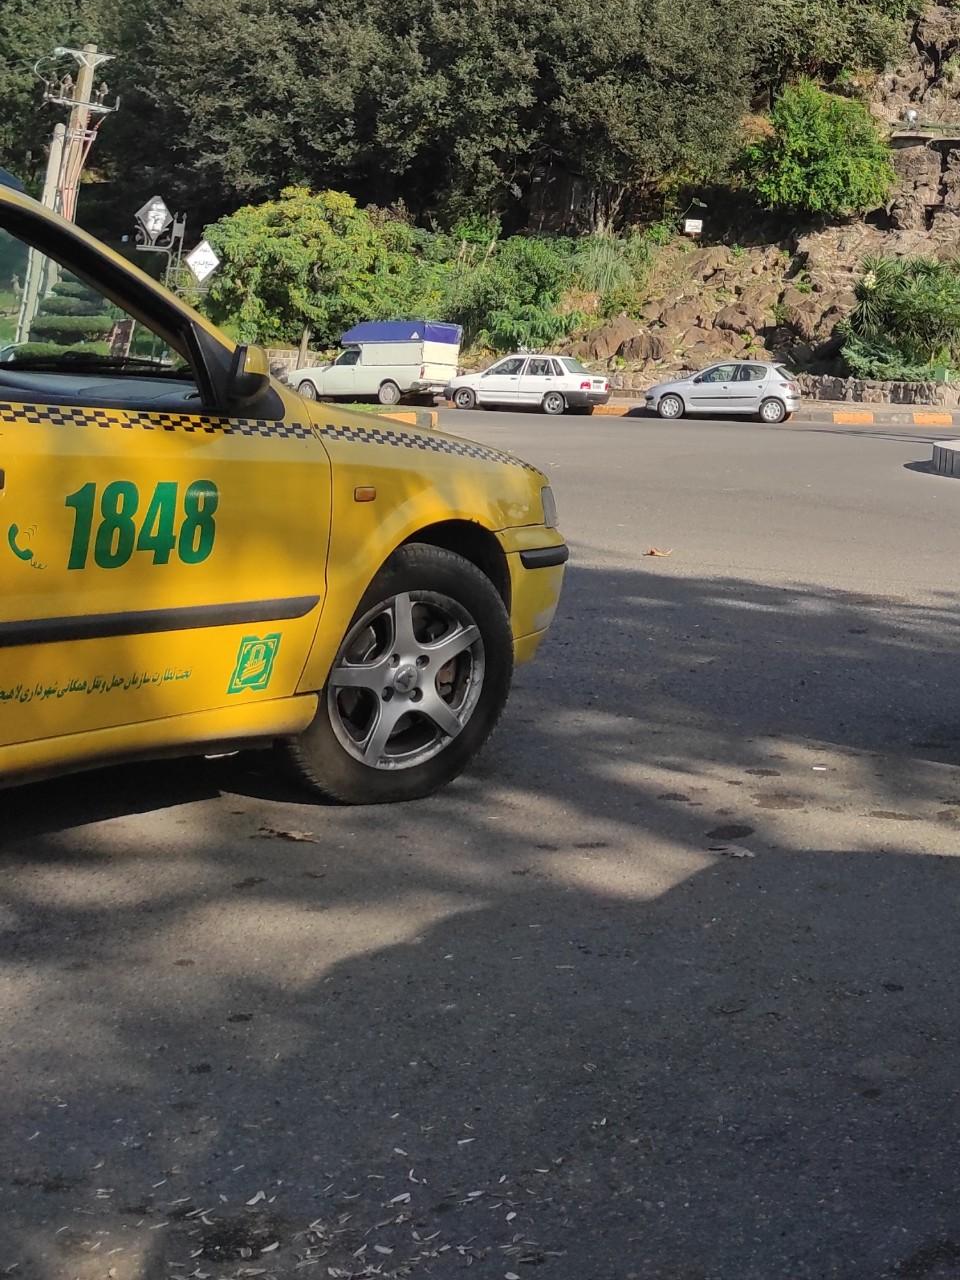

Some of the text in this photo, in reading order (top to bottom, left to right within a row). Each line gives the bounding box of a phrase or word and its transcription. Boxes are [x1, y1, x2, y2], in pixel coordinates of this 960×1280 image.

[65, 480, 220, 570] 1848
[86, 675, 102, 694] نقل
[106, 675, 124, 692] حمل
[124, 672, 151, 690] سازمان
[0, 682, 23, 704] لاهیج
